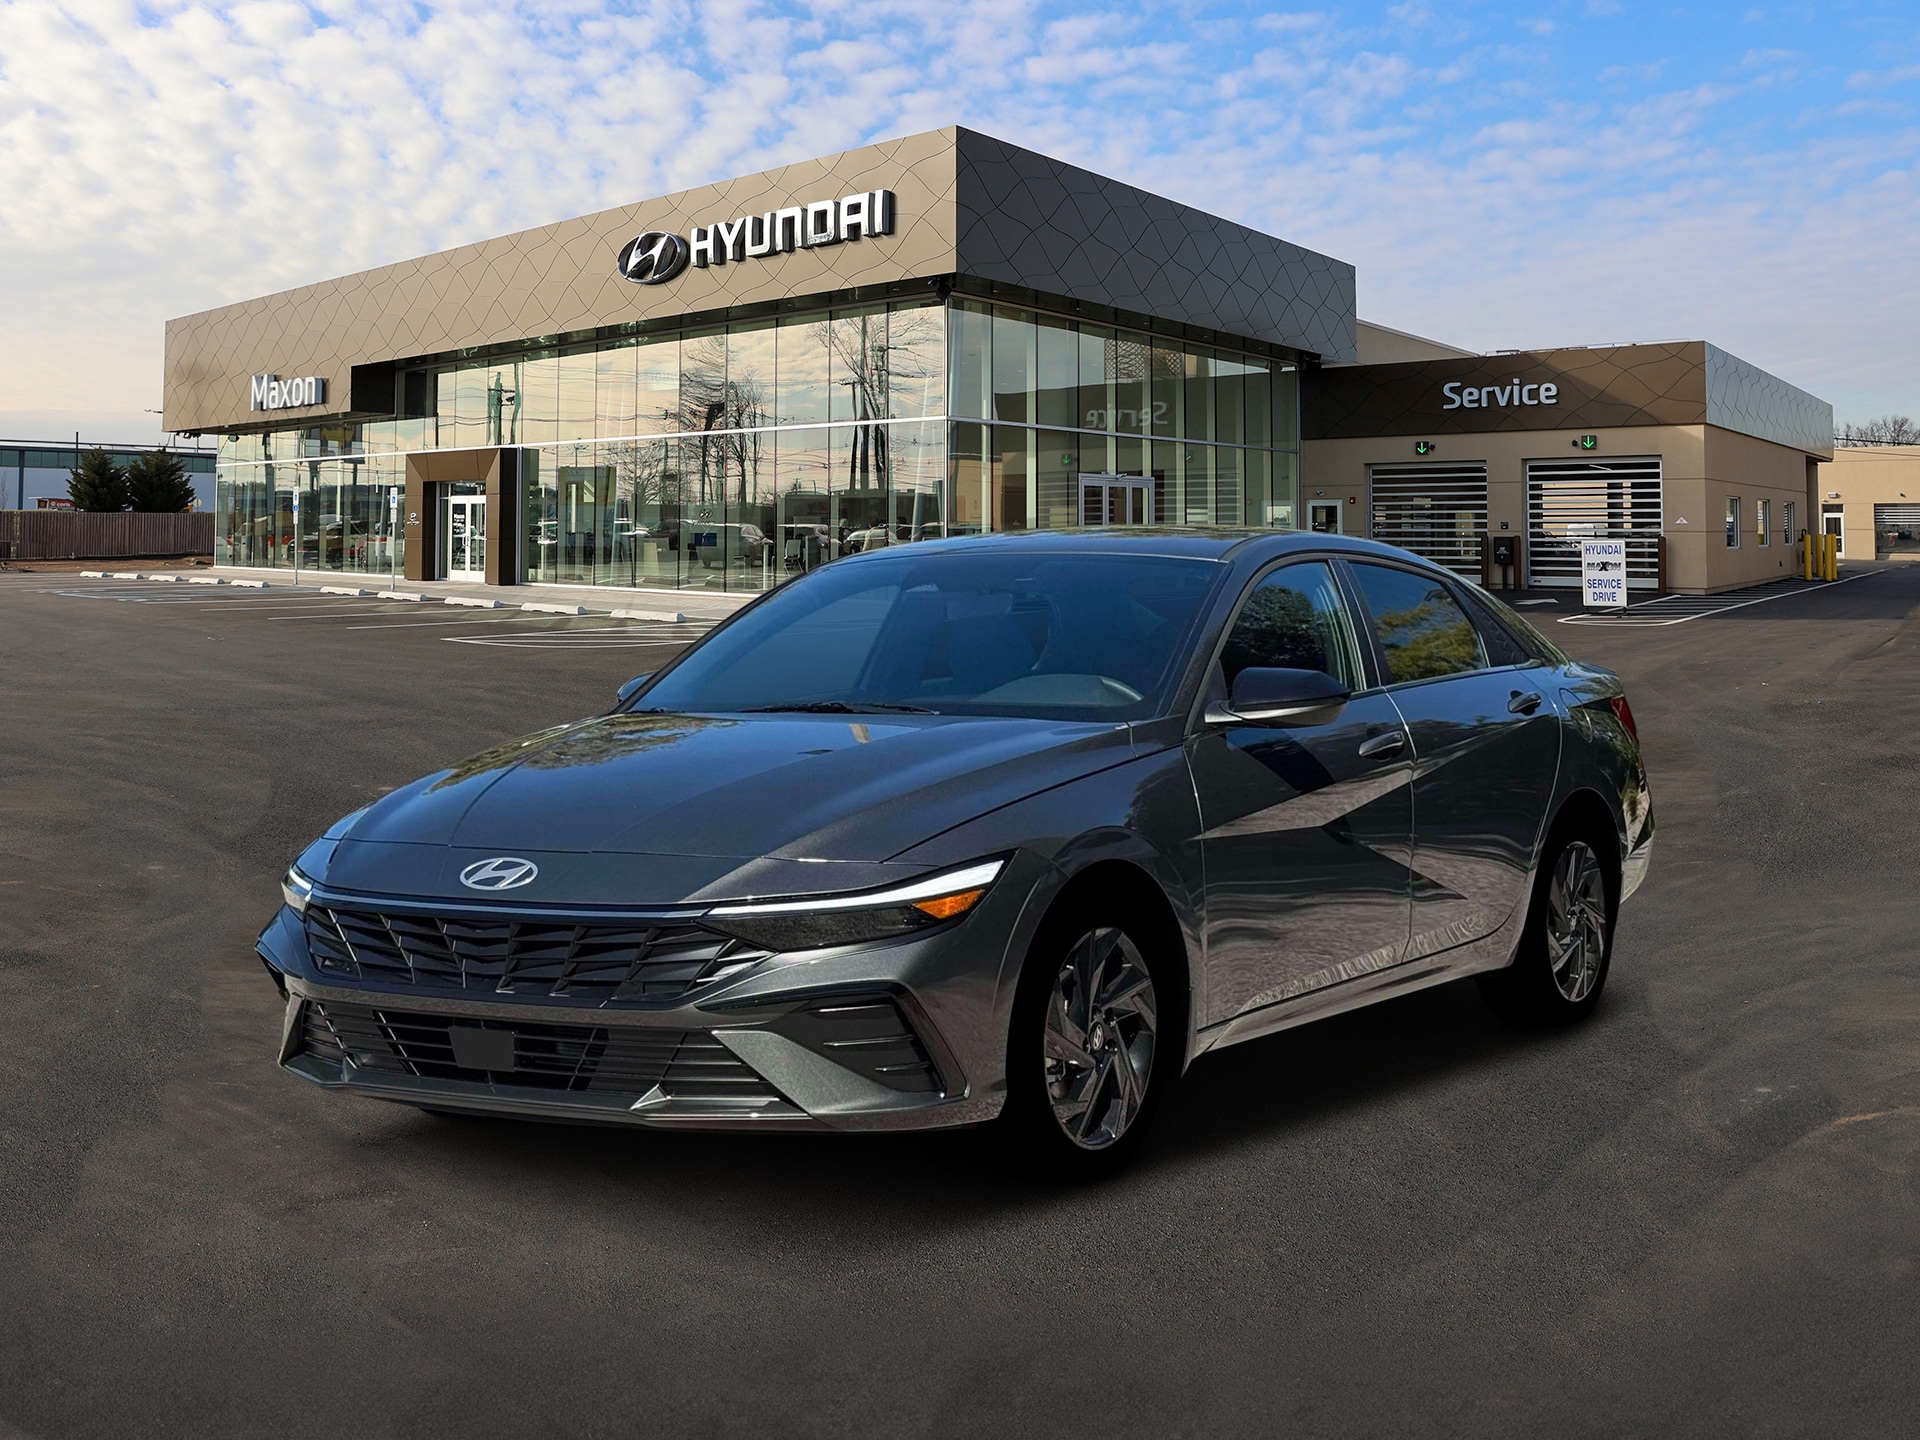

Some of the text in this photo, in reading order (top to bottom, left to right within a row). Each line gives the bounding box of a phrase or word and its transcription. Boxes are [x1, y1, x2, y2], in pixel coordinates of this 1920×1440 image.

[690, 189, 890, 266] HYUNDAI
[251, 374, 319, 411] Maxon
[1443, 378, 1558, 409] Service
[1585, 545, 1622, 555] HYUNDAI
[1586, 561, 1622, 571] MAXON
[1587, 579, 1622, 589] SERVICE
[1593, 592, 1617, 602] DRIVE
